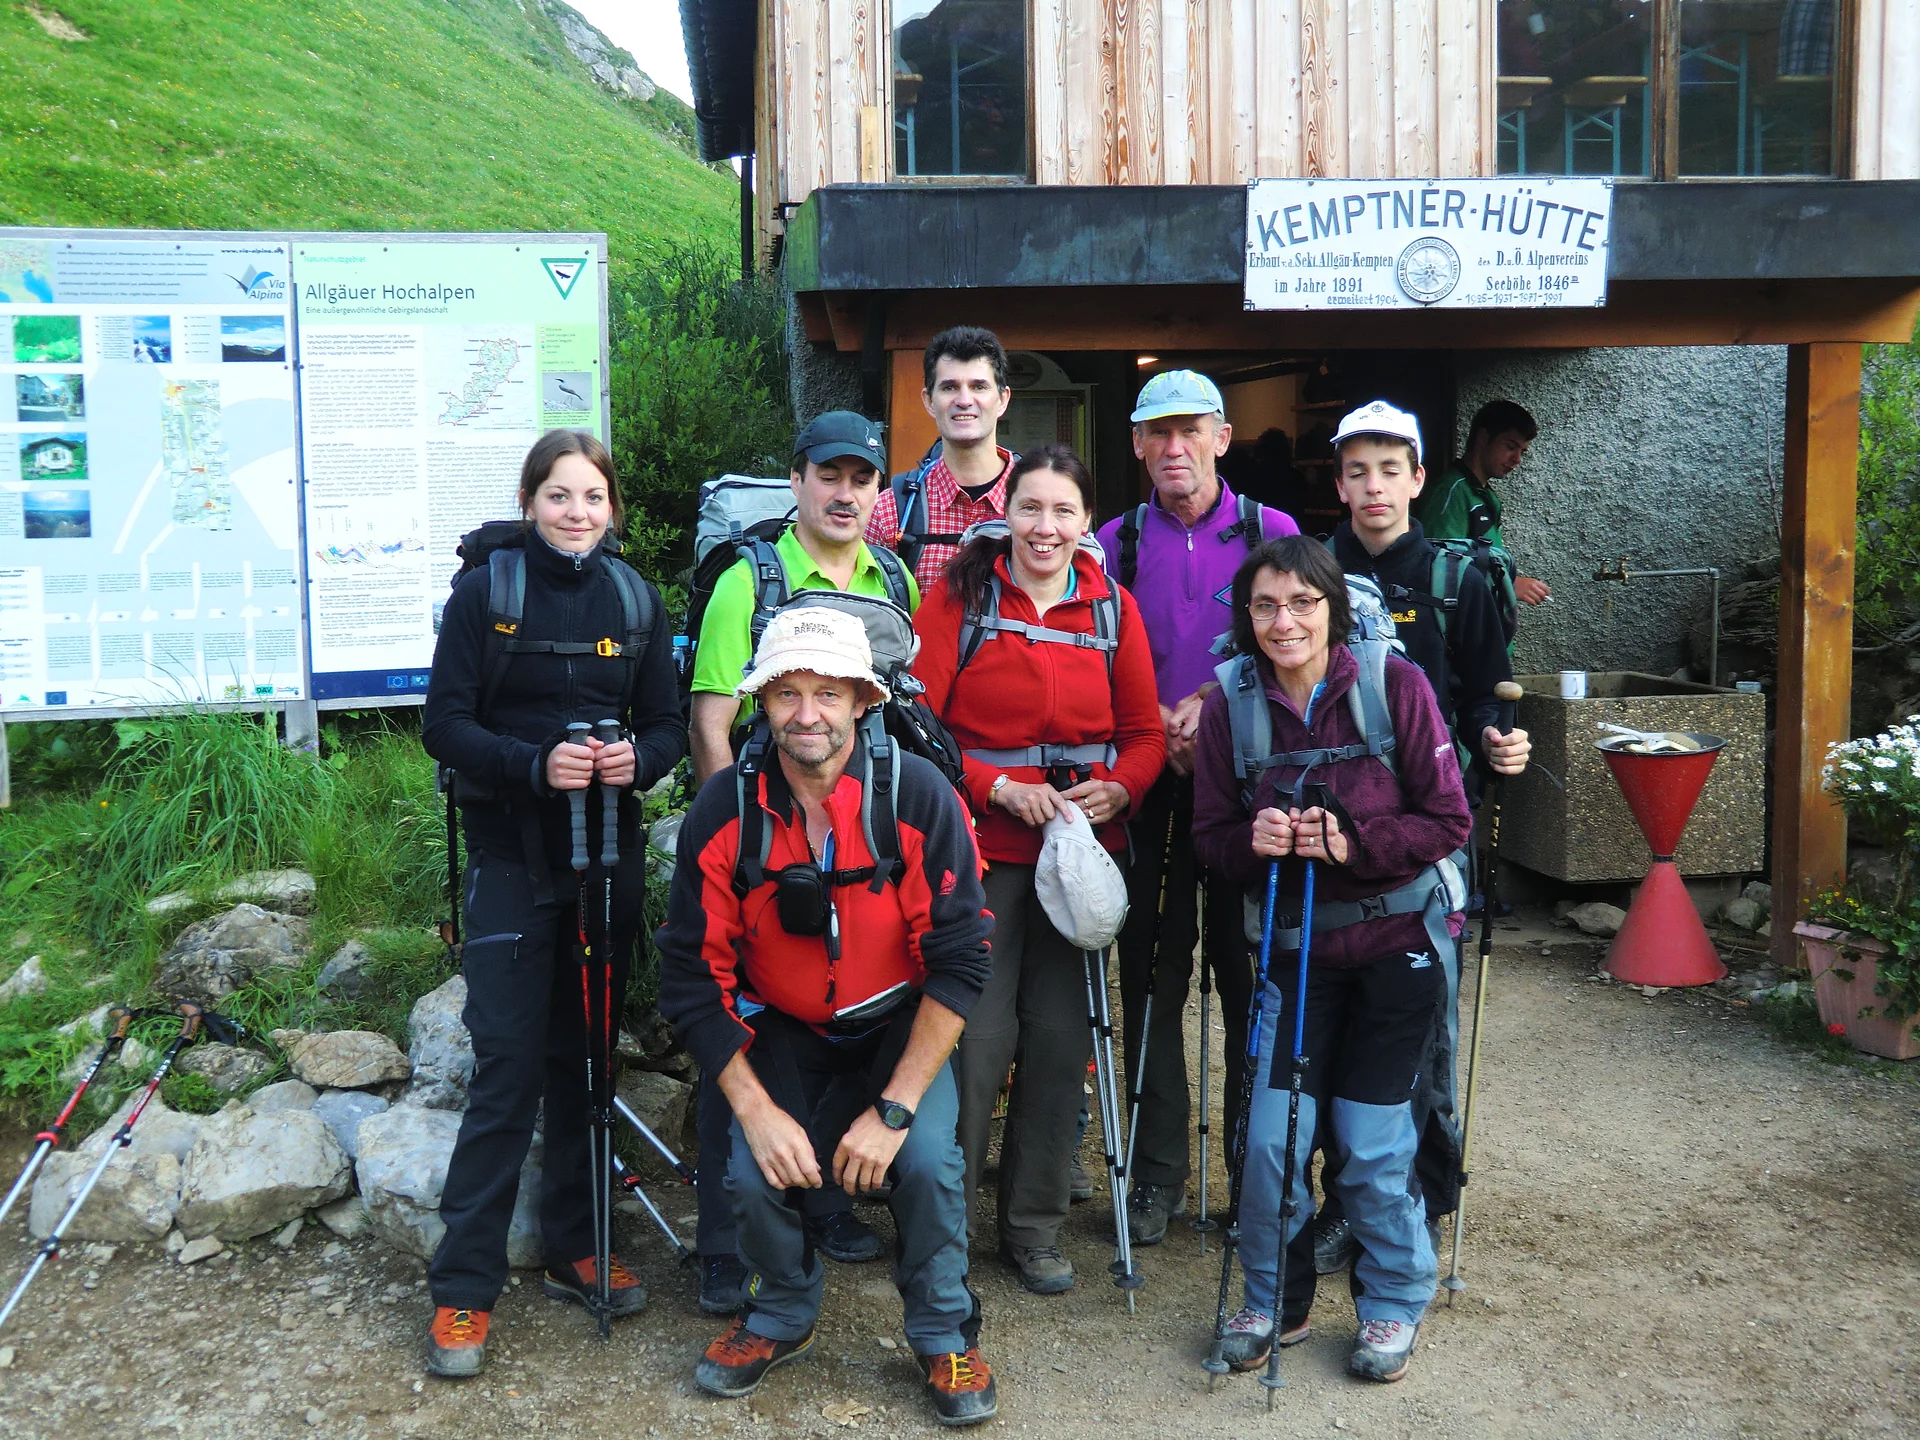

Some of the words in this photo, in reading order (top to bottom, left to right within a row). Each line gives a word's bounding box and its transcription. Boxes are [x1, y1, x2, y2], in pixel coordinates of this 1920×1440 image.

[1249, 252, 1280, 267] Erbaut
[1526, 250, 1589, 270] Alpenvereins
[269, 279, 285, 288] Via
[1275, 279, 1288, 292] im
[1295, 278, 1326, 292] Jahre
[1333, 277, 1362, 292] 1891
[1486, 275, 1531, 290] Seehöhe
[249, 290, 283, 301] Alpina
[305, 283, 376, 304] Allgäuer
[382, 283, 475, 303] Hochalpen
[1327, 293, 1373, 304] erweitert
[1375, 294, 1398, 306] 1904
[323, 306, 386, 314] außergewöhnliche
[388, 306, 448, 314] Gebirgslandschaft
